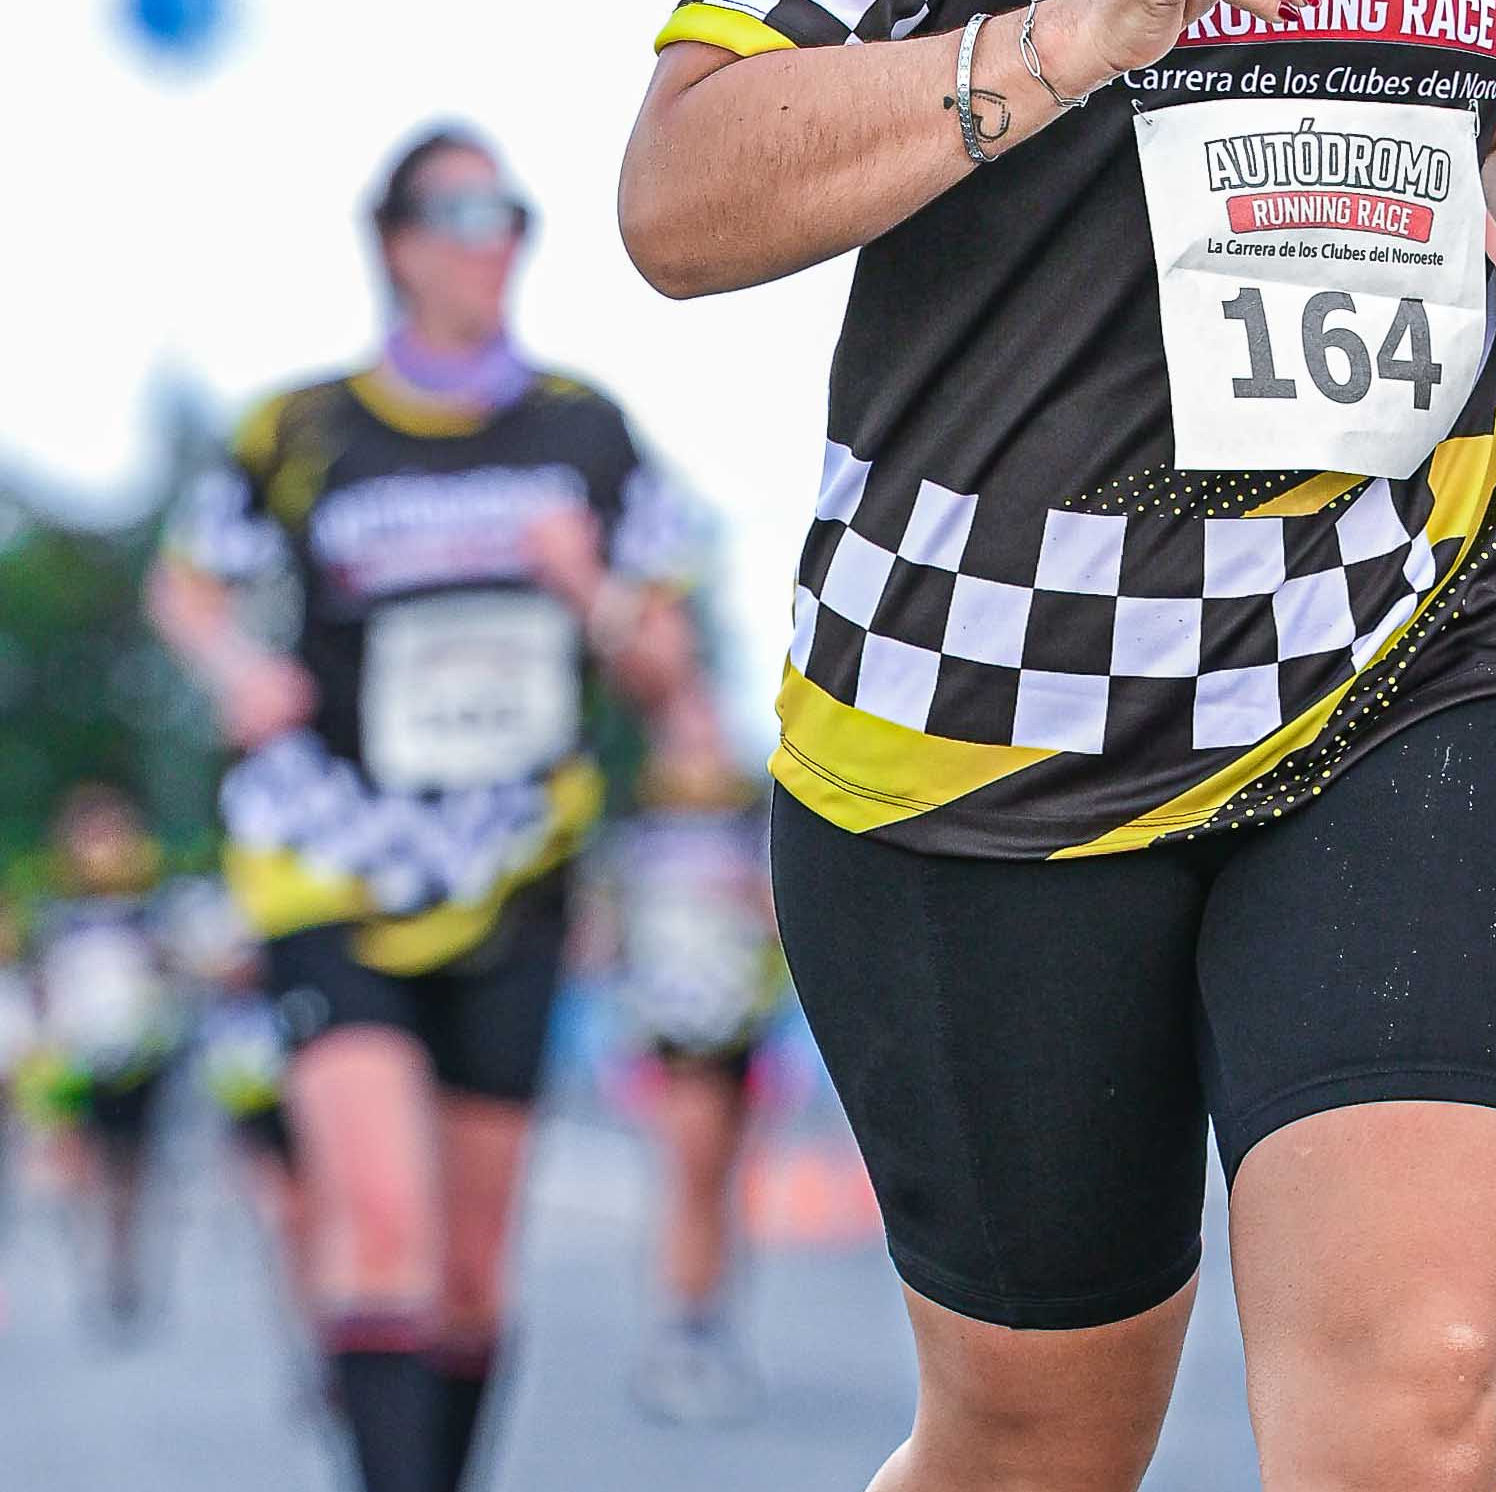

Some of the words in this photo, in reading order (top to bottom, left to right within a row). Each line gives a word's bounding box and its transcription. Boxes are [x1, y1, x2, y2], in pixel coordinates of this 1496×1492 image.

[1123, 68, 1232, 92] Carrera
[1240, 65, 1277, 94] de
[1283, 65, 1320, 95] los
[1325, 66, 1412, 96] Clubes
[1417, 70, 1460, 99] del
[1204, 117, 1452, 202] AUTÓDROMO
[1252, 195, 1351, 227] RUNNING
[1357, 198, 1412, 235] RACE
[1207, 238, 1223, 254] La
[1226, 239, 1275, 257] Carrera
[1279, 241, 1296, 258] de
[1299, 242, 1318, 258] los
[1321, 243, 1366, 262] Clubes
[1369, 246, 1389, 263] del
[1392, 249, 1444, 266] Noroeste
[1221, 287, 1442, 411] 164
